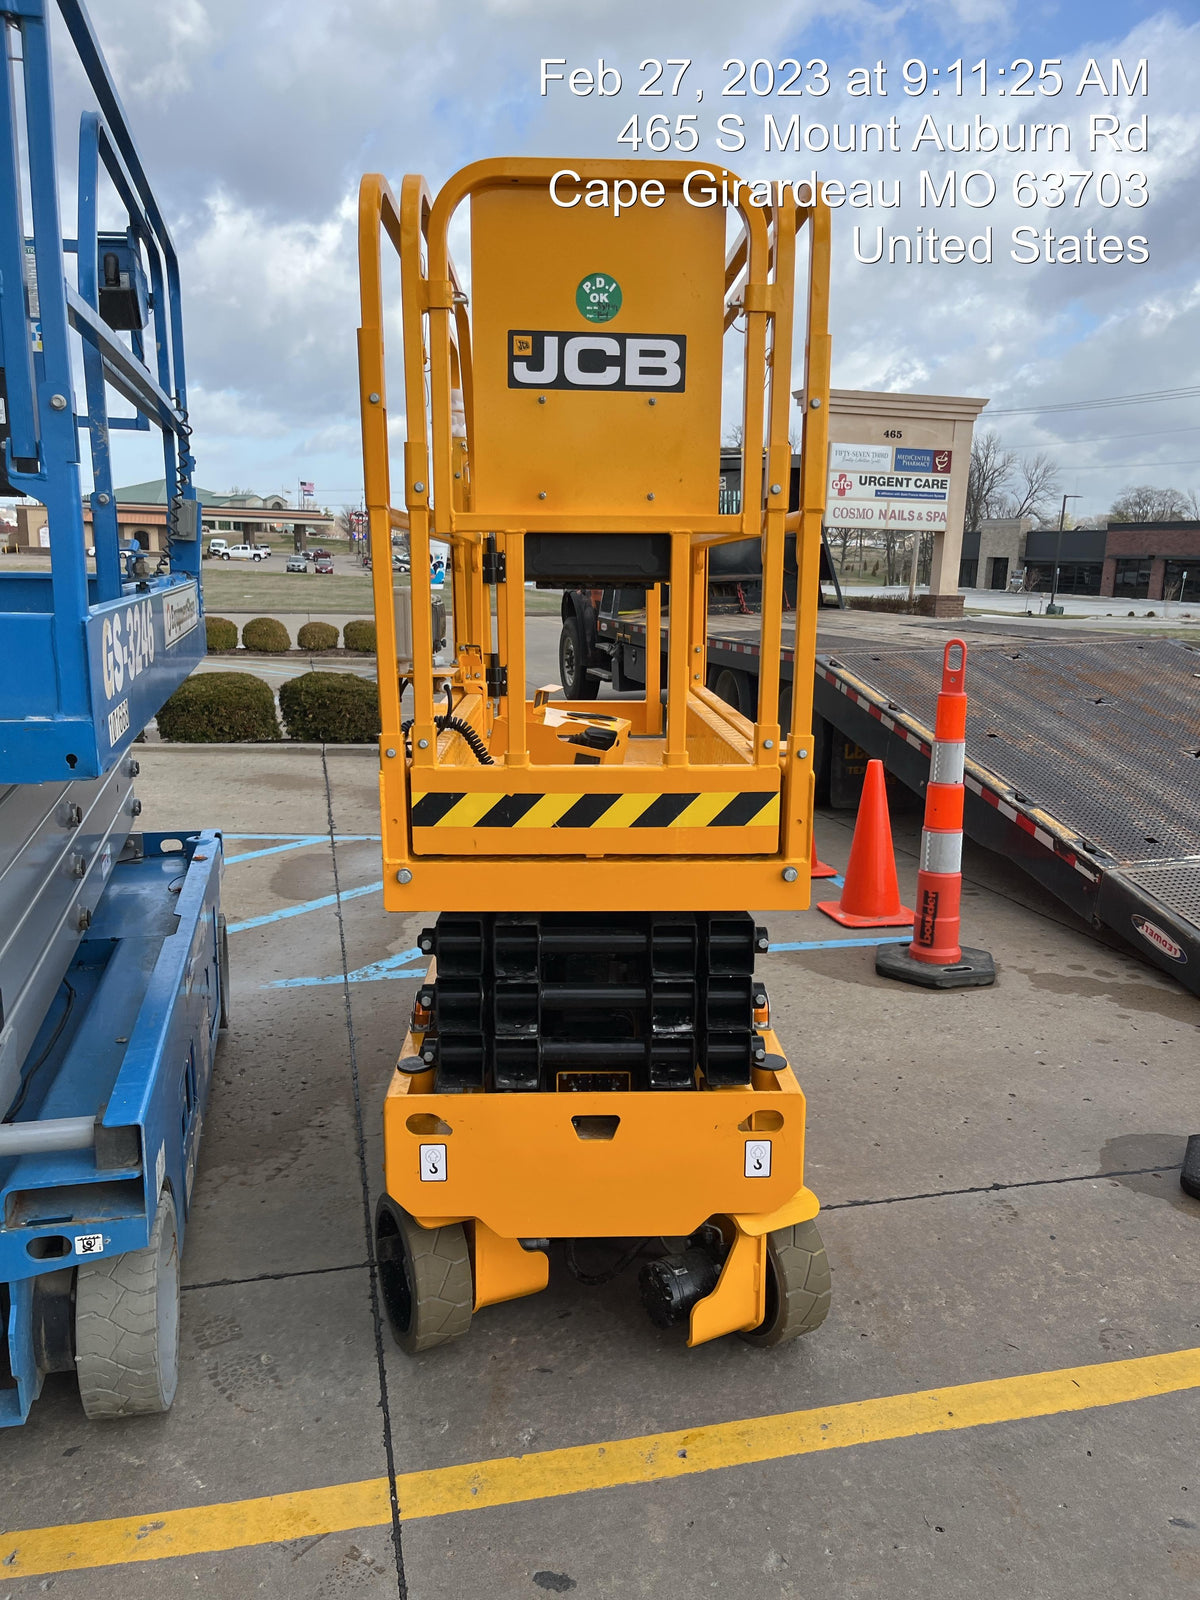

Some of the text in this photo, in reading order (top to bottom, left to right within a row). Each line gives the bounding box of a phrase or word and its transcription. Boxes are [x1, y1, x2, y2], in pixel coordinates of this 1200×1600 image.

[589, 293, 609, 303] OK
[513, 335, 682, 387] JCB
[883, 430, 902, 439] 465
[832, 477, 852, 490] afc
[858, 475, 948, 490] URGENT CARE
[832, 507, 947, 522] COSMO NAILS & SPA
[103, 599, 154, 700] GS-3246
